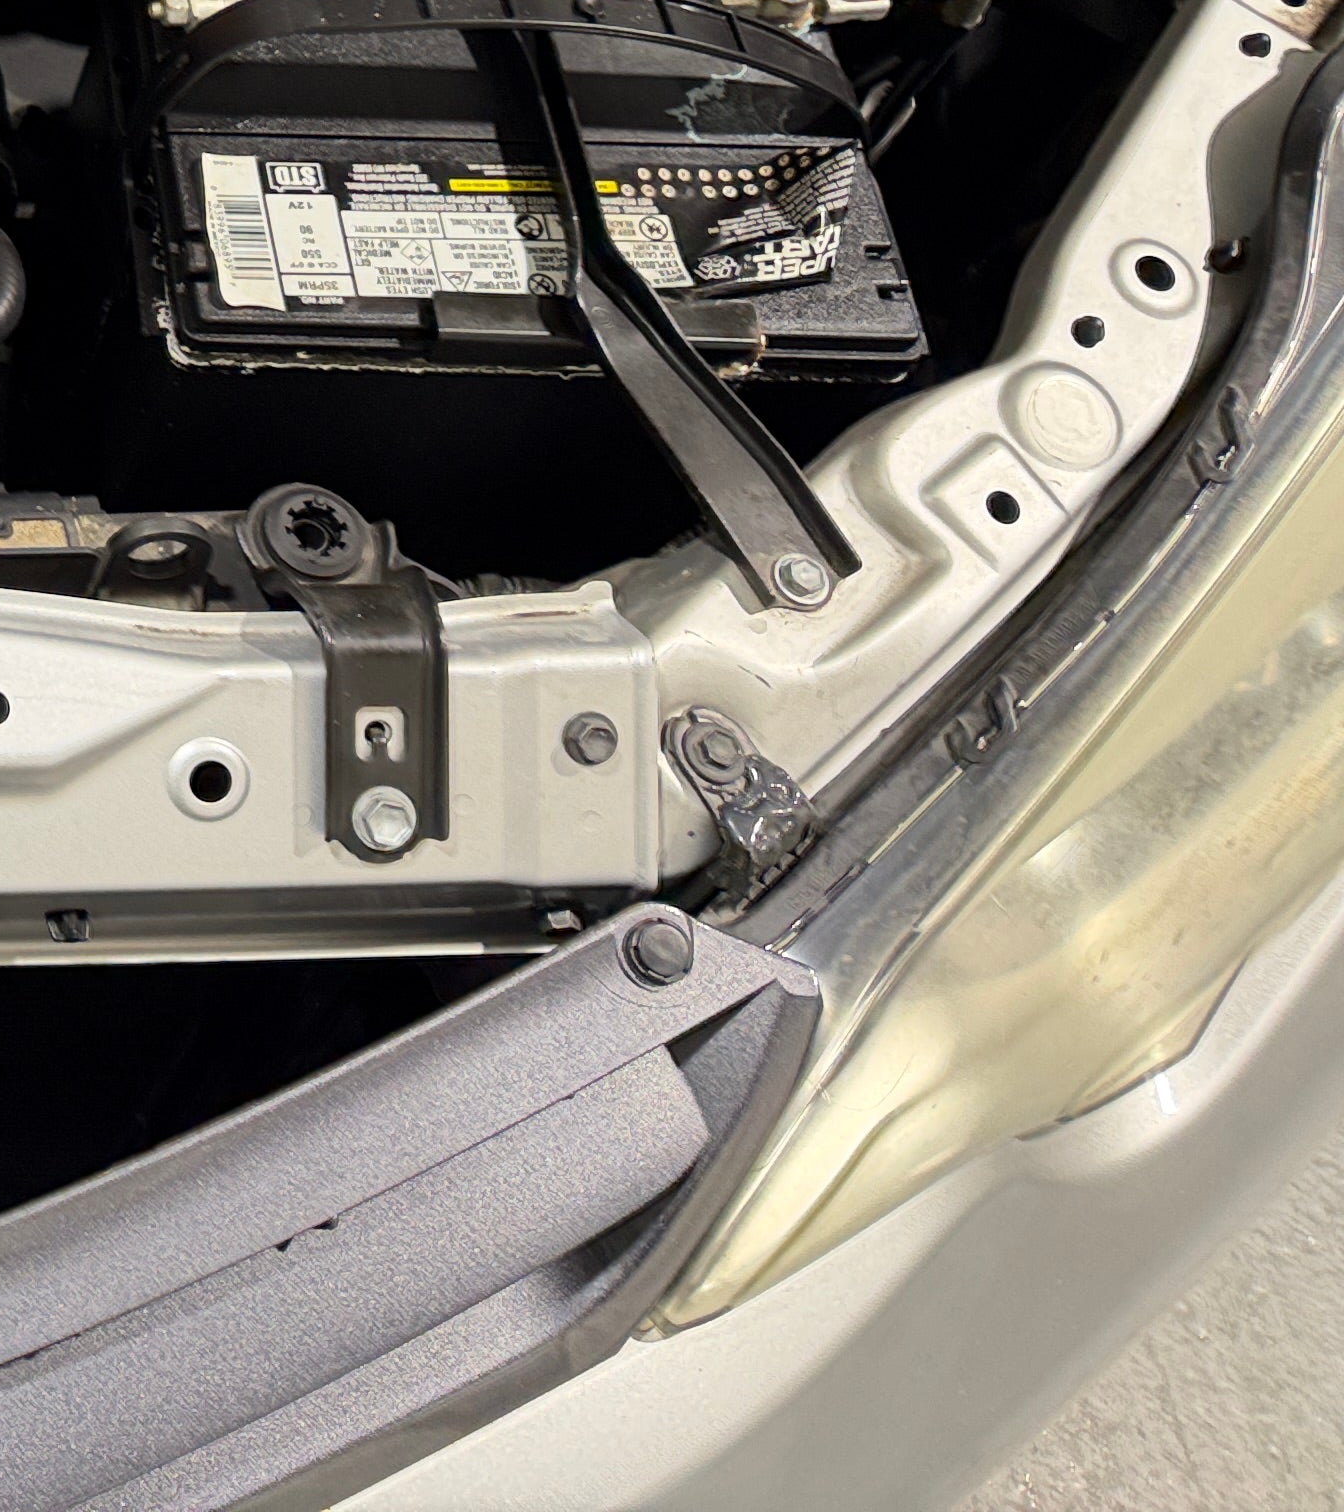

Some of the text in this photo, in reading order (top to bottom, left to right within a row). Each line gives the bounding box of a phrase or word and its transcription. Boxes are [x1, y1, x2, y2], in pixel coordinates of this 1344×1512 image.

[274, 166, 316, 185] STD
[288, 201, 313, 210] 12V
[756, 249, 836, 281] UPER
